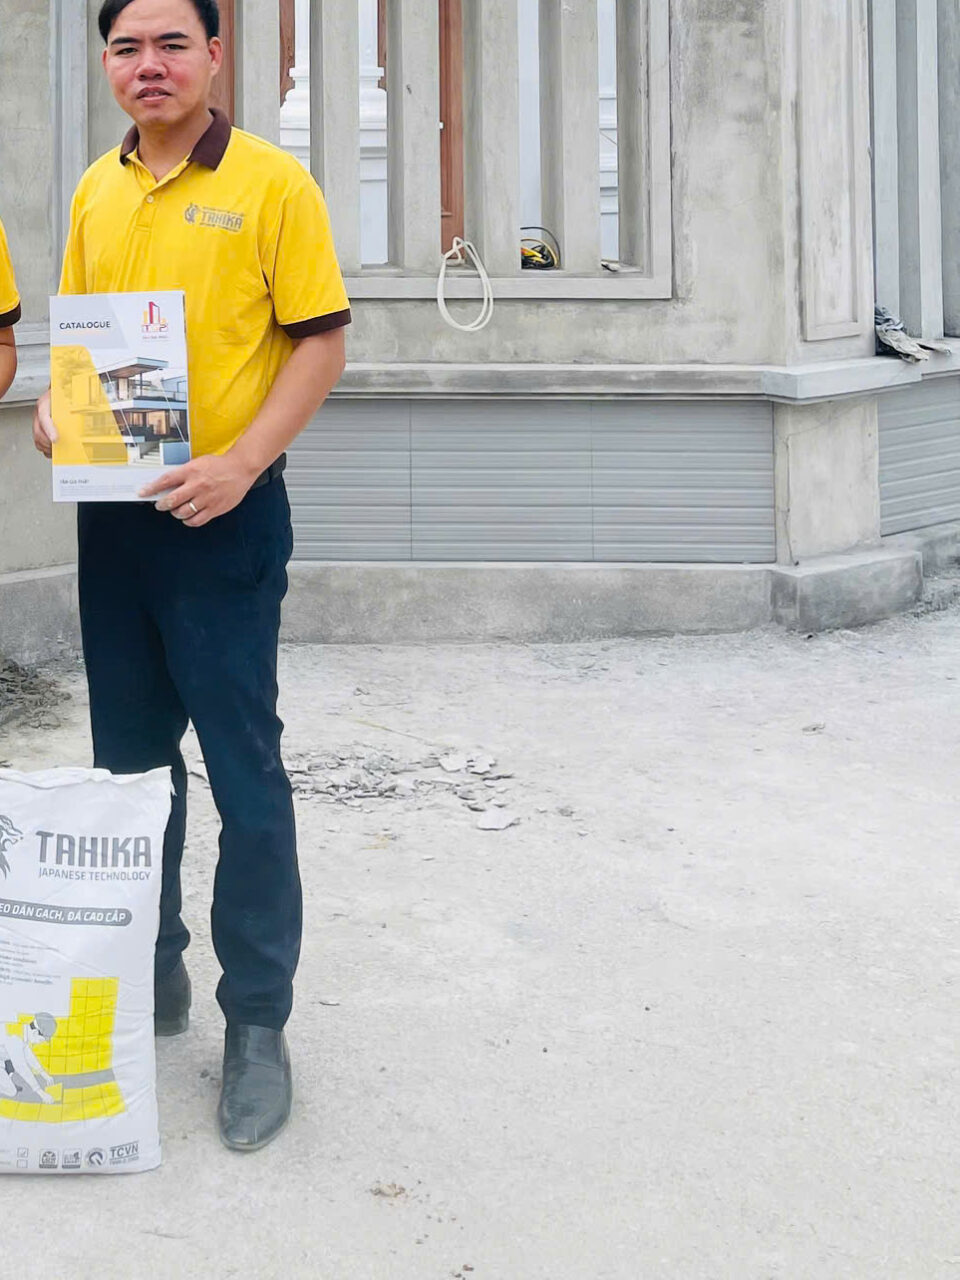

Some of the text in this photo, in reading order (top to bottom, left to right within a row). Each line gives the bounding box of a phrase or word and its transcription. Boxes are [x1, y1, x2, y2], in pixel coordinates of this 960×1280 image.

[201, 211, 243, 230] TAHIKA
[59, 321, 111, 330] CATALOGUE
[35, 830, 152, 868] TAHIKA
[39, 867, 151, 881] JAPANESE TECHNOLOGY
[84, 911, 104, 921] CAO
[110, 1143, 139, 1158] TCVN
